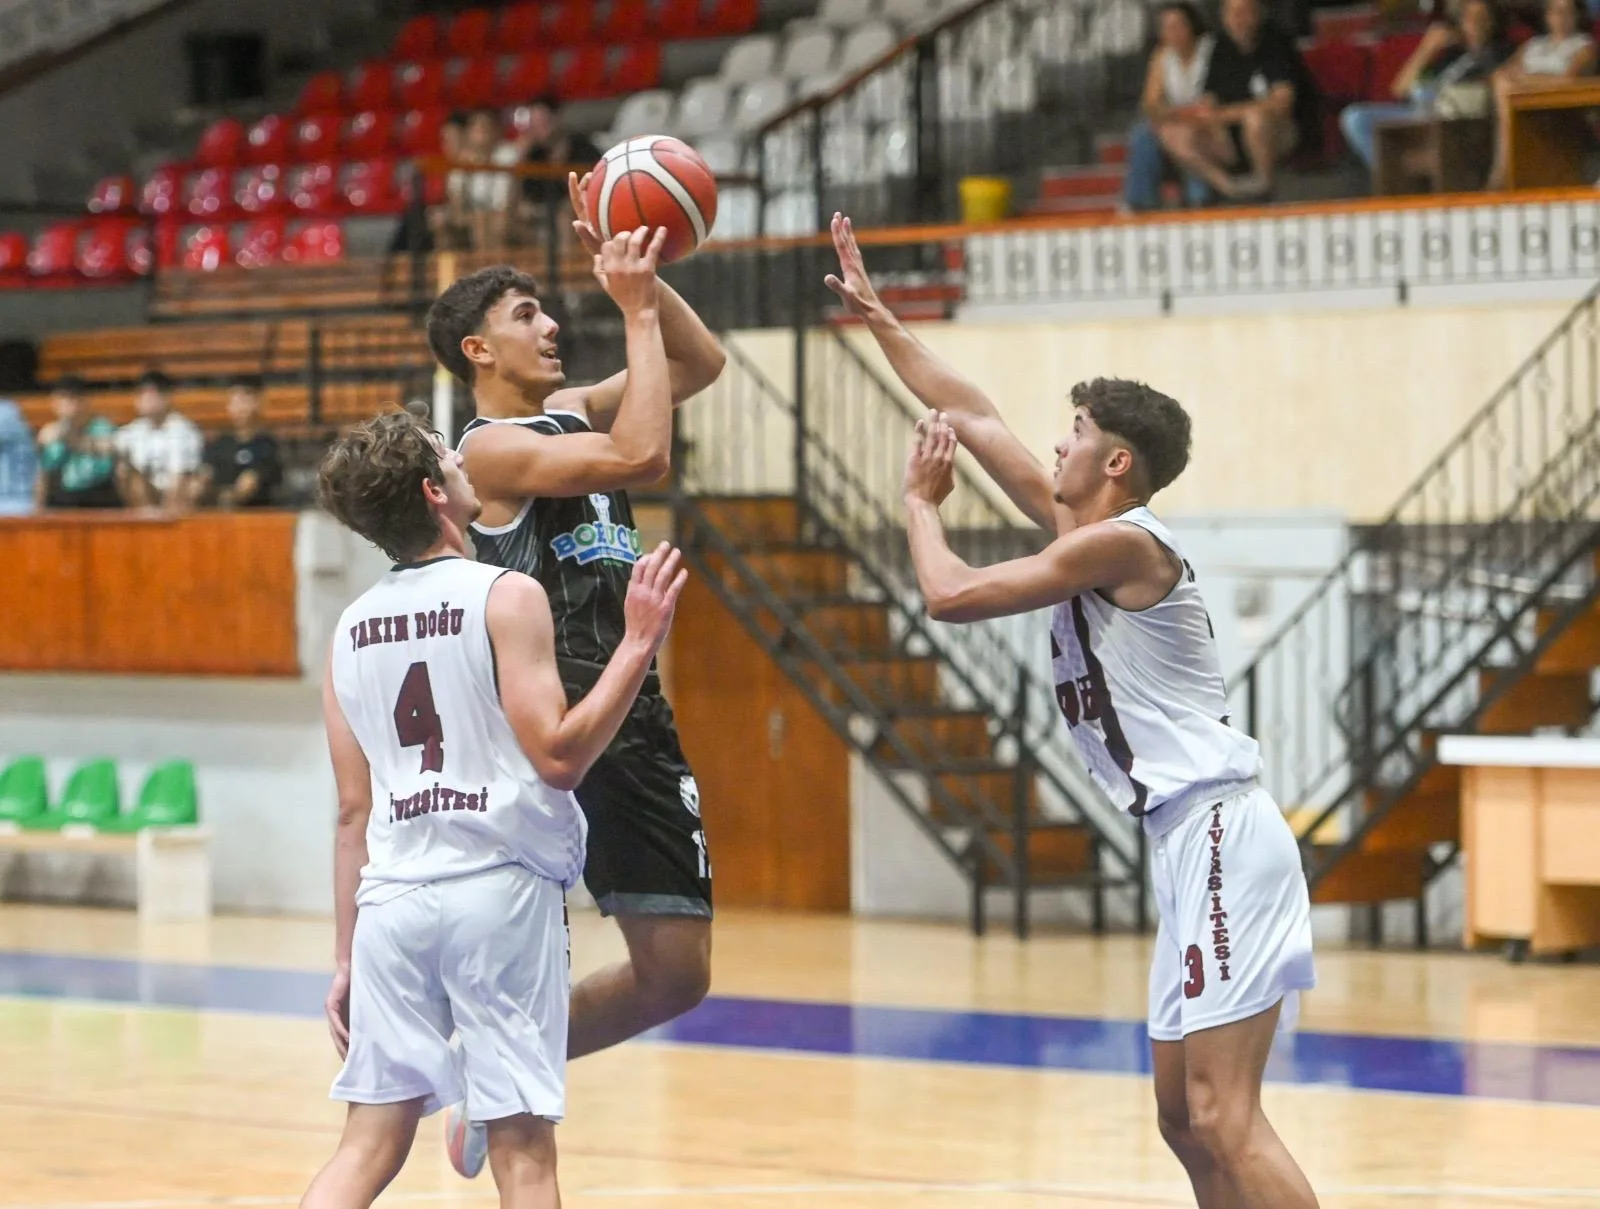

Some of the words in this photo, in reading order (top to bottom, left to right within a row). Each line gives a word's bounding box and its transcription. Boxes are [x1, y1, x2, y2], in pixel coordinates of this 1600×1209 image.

[350, 614, 409, 652] YAKIN
[414, 601, 465, 639] DOĞU
[393, 661, 444, 774] 4
